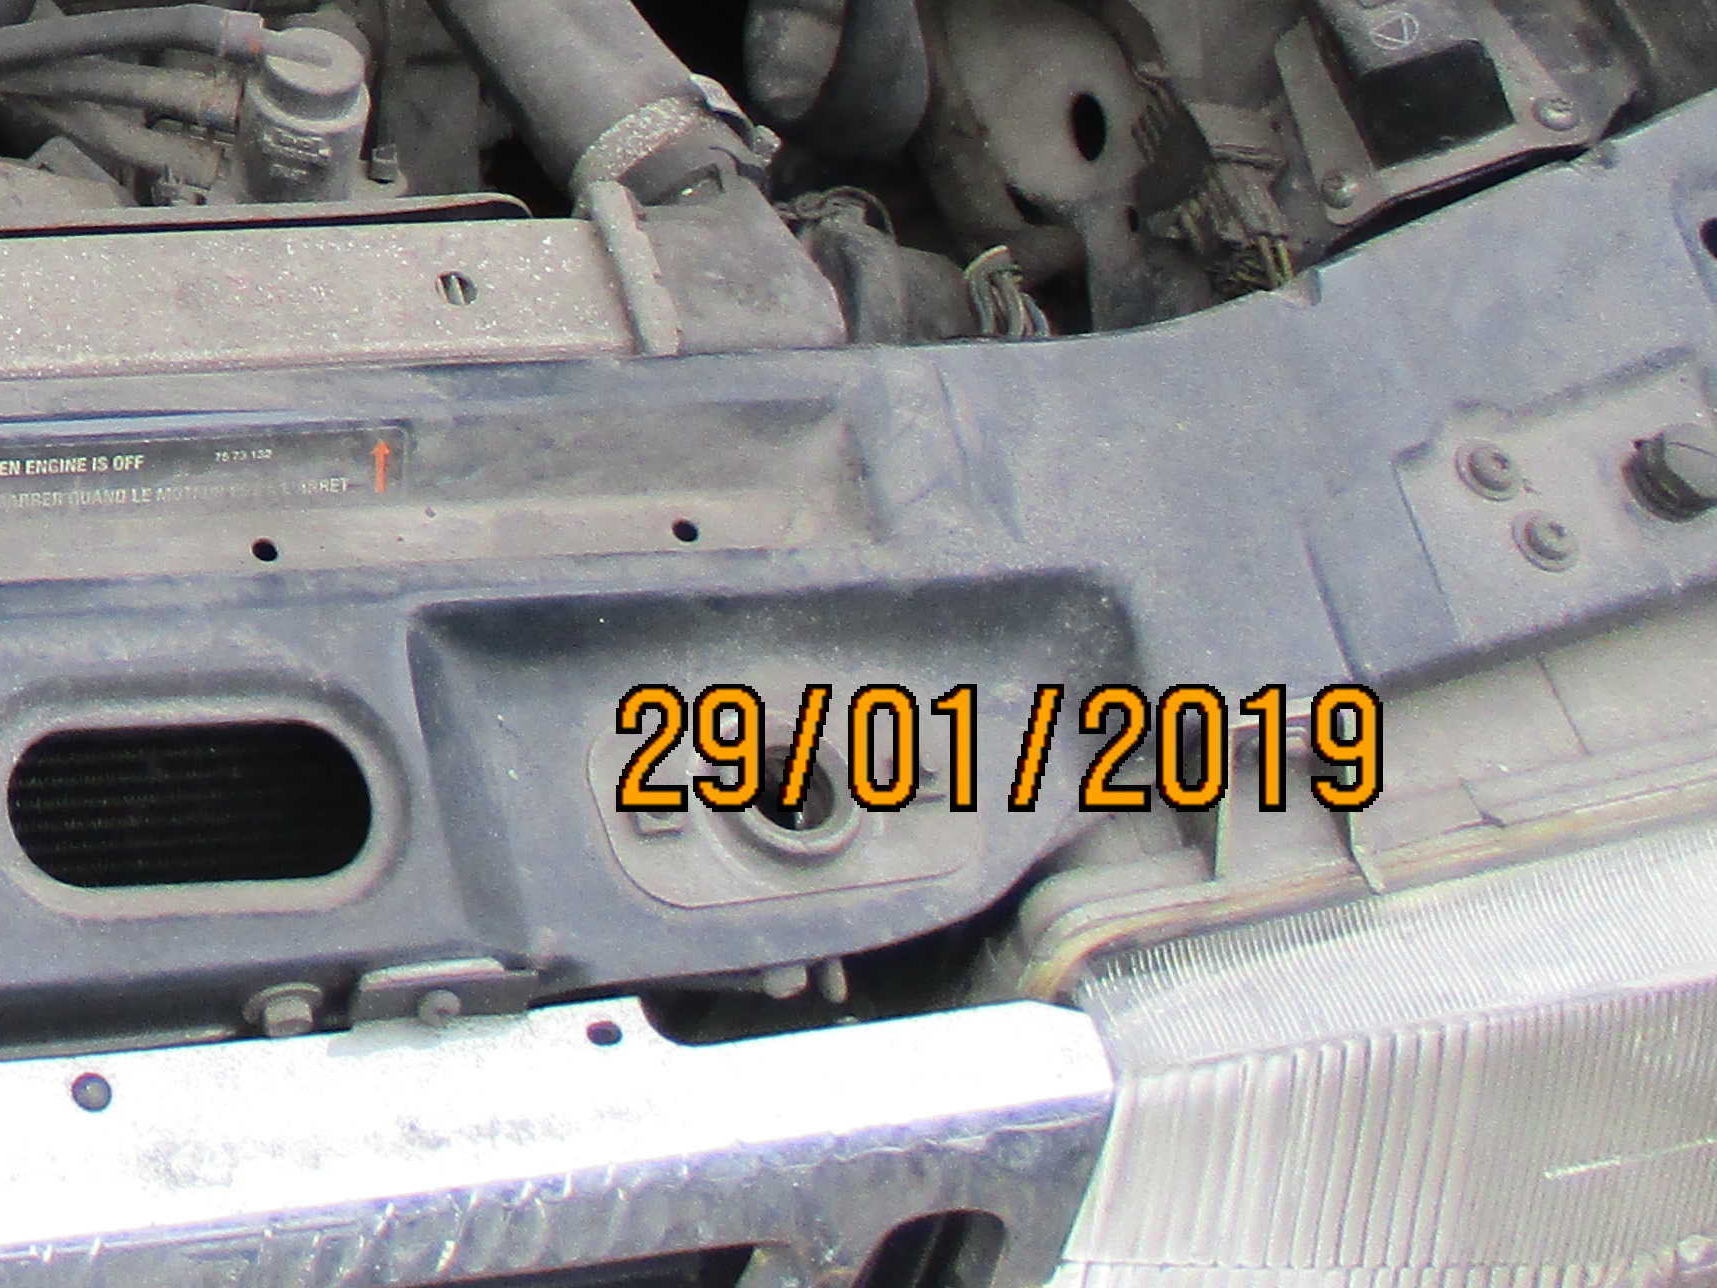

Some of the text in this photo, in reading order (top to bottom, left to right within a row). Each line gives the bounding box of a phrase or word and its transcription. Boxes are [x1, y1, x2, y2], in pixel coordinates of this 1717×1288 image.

[24, 456, 87, 476] ENGINE
[91, 455, 108, 473] IS
[112, 454, 146, 473] OFF
[131, 486, 153, 504] LE
